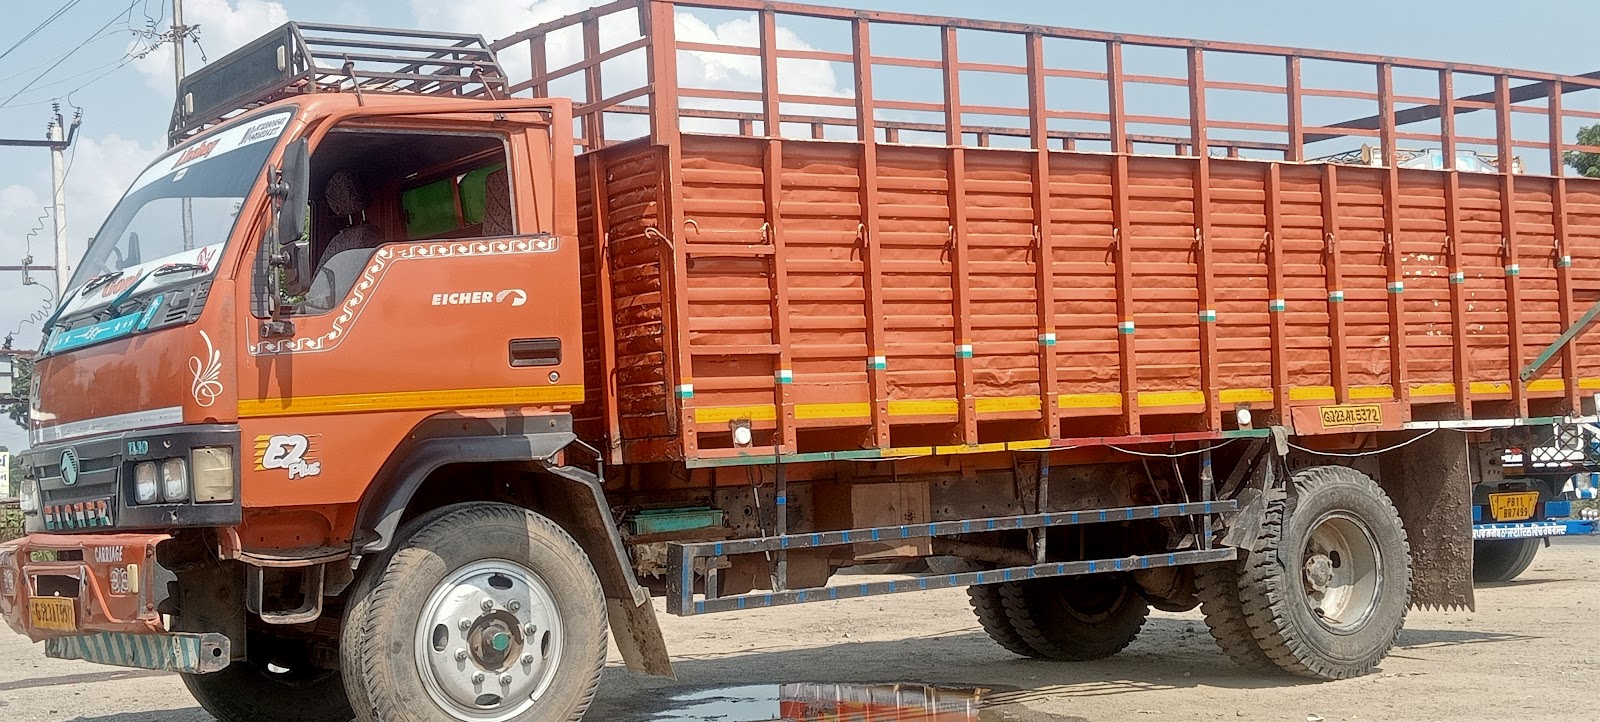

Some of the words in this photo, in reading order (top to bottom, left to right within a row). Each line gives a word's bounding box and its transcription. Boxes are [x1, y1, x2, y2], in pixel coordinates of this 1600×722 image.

[431, 291, 494, 306] EICHER
[288, 460, 321, 480] Plus
[43, 500, 113, 530] EICHER
[94, 546, 123, 563] CARRIAGE
